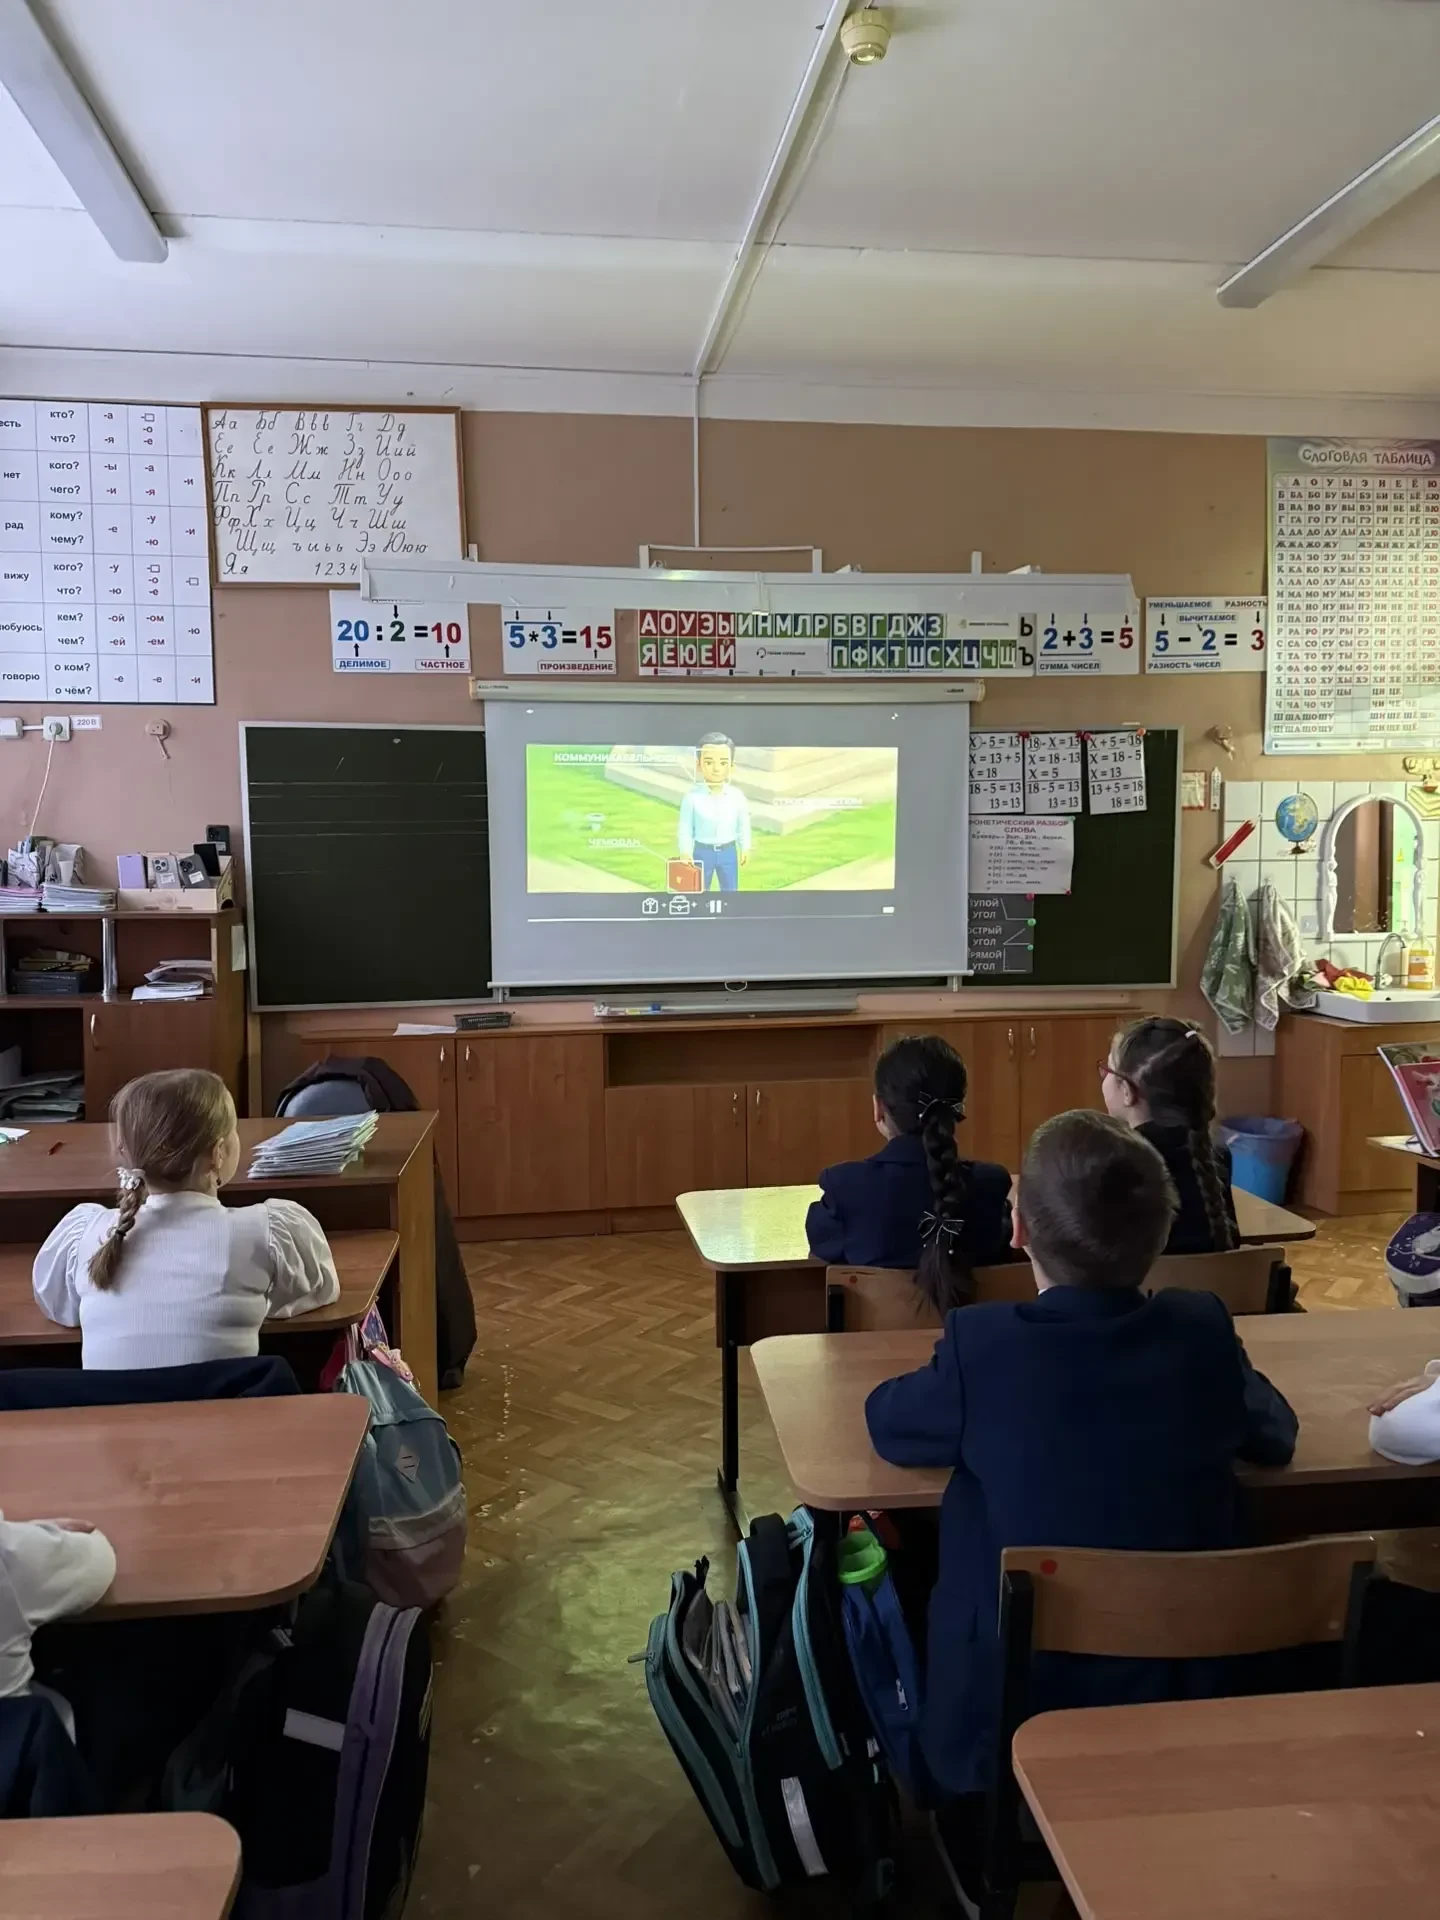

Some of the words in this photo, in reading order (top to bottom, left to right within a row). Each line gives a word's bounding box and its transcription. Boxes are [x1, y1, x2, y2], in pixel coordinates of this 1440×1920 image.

[50, 410, 74, 418] кто?
[51, 434, 76, 443] что?
[1302, 449, 1368, 464] СЛОГОВАЯ
[1374, 452, 1432, 467] ТАБЛИЦА
[50, 461, 79, 469] кого?
[50, 485, 80, 493] чего?
[50, 511, 83, 521] кому?
[5, 522, 24, 530] рад
[51, 535, 84, 545] чему?
[54, 563, 83, 571] кого?
[4, 573, 29, 581] вижу
[57, 586, 82, 595] что?
[57, 613, 83, 621] кем?
[1179, 614, 1237, 622] ВЫЧИТАЕМОЕ
[58, 636, 85, 645] чем?
[64, 663, 91, 671] ком?
[340, 660, 387, 668] ДЕЛИМОЕ
[421, 661, 465, 669] ЧАСТНОЕ
[540, 663, 613, 671] ПРОИЗВЕДЕНИЕ
[1071, 662, 1100, 670] ЧИСЕЛ
[1148, 662, 1191, 670] РАЗНОСТЬ
[2, 673, 40, 681] говорю
[970, 898, 999, 908] УПОЙ
[973, 911, 995, 919] УГОЛ
[969, 950, 1002, 958] РЯМОЙ
